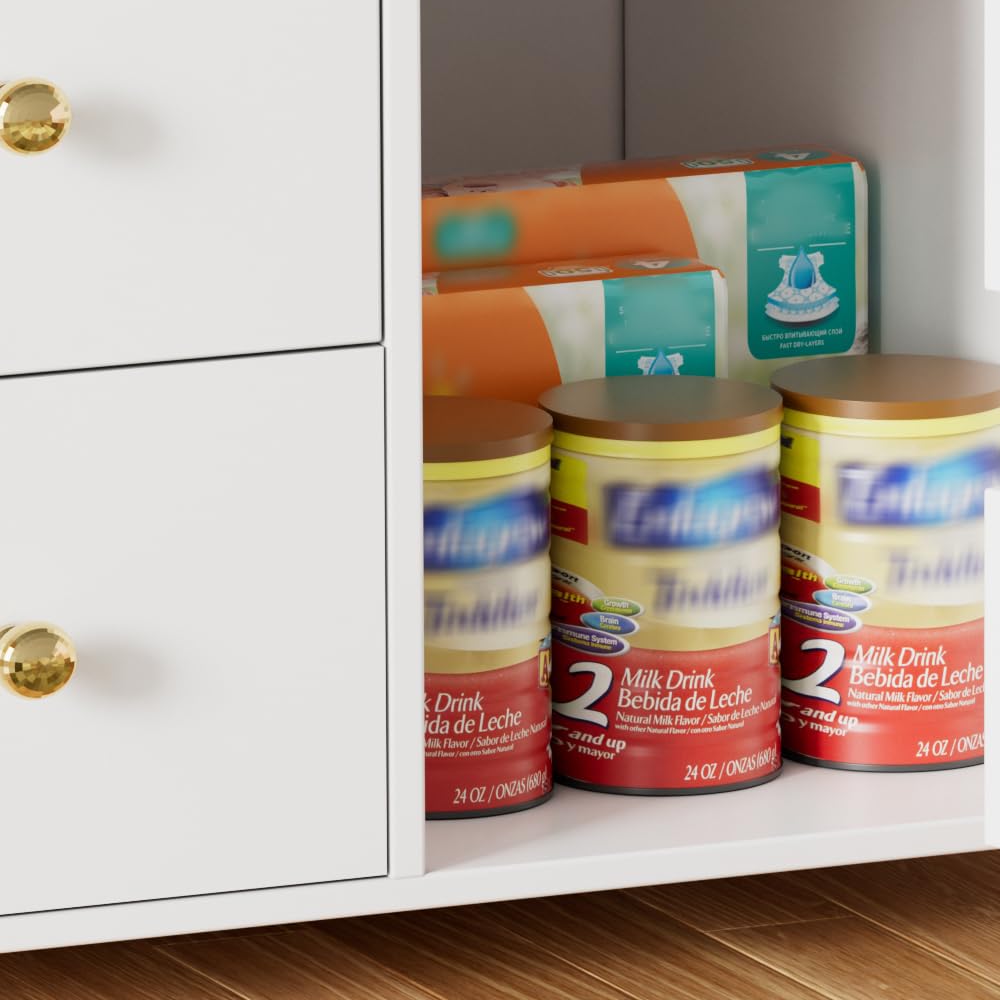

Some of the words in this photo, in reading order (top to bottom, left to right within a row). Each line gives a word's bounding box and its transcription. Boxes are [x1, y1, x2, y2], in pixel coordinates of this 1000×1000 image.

[600, 614, 620, 625] Brain
[591, 634, 618, 646] System
[853, 644, 895, 667] Milk
[898, 645, 947, 667] Drink
[621, 667, 664, 689] Milk
[666, 668, 715, 690] Drink
[783, 638, 845, 705] 2
[850, 666, 913, 688] Bebida
[917, 667, 938, 688] de
[941, 662, 983, 686] Leche
[435, 691, 484, 713] Drink
[552, 661, 614, 729] 2
[617, 688, 681, 711] Bebida
[684, 689, 707, 711] de
[710, 685, 752, 710] Leche
[848, 687, 886, 700] Natural
[886, 691, 905, 703] Milk
[907, 691, 932, 703] Flavor
[939, 689, 961, 701] Sabor
[962, 687, 972, 697] de
[616, 711, 652, 724] Natural
[653, 715, 673, 725] Milk
[675, 715, 700, 726] Flavor
[707, 712, 730, 724] Sabor
[730, 710, 740, 720] de
[741, 705, 759, 719] Leche
[800, 707, 838, 722] and
[838, 714, 859, 729] up
[879, 703, 900, 711] Natural
[901, 703, 918, 711] Flavor
[453, 714, 476, 735] de
[479, 708, 522, 733] Leche
[629, 725, 646, 733] other
[647, 726, 669, 734] Natural
[669, 727, 686, 735] Flavor
[713, 724, 727, 732] Sabor
[809, 721, 848, 737] mayor
[443, 738, 469, 749] Flavor
[477, 735, 500, 748] Sabor
[500, 732, 510, 743] de
[510, 726, 530, 741] Leche
[568, 730, 605, 746] and
[606, 738, 627, 753] up
[915, 741, 930, 757] 24
[932, 740, 949, 756] OZ
[438, 750, 455, 758] Flavor
[578, 745, 616, 760] mayor
[684, 764, 698, 781] 24
[701, 762, 717, 780] OZ
[726, 754, 756, 776] ONZAS
[453, 788, 467, 804] 24
[469, 786, 486, 803] OZ
[495, 778, 526, 800] ONZAS
